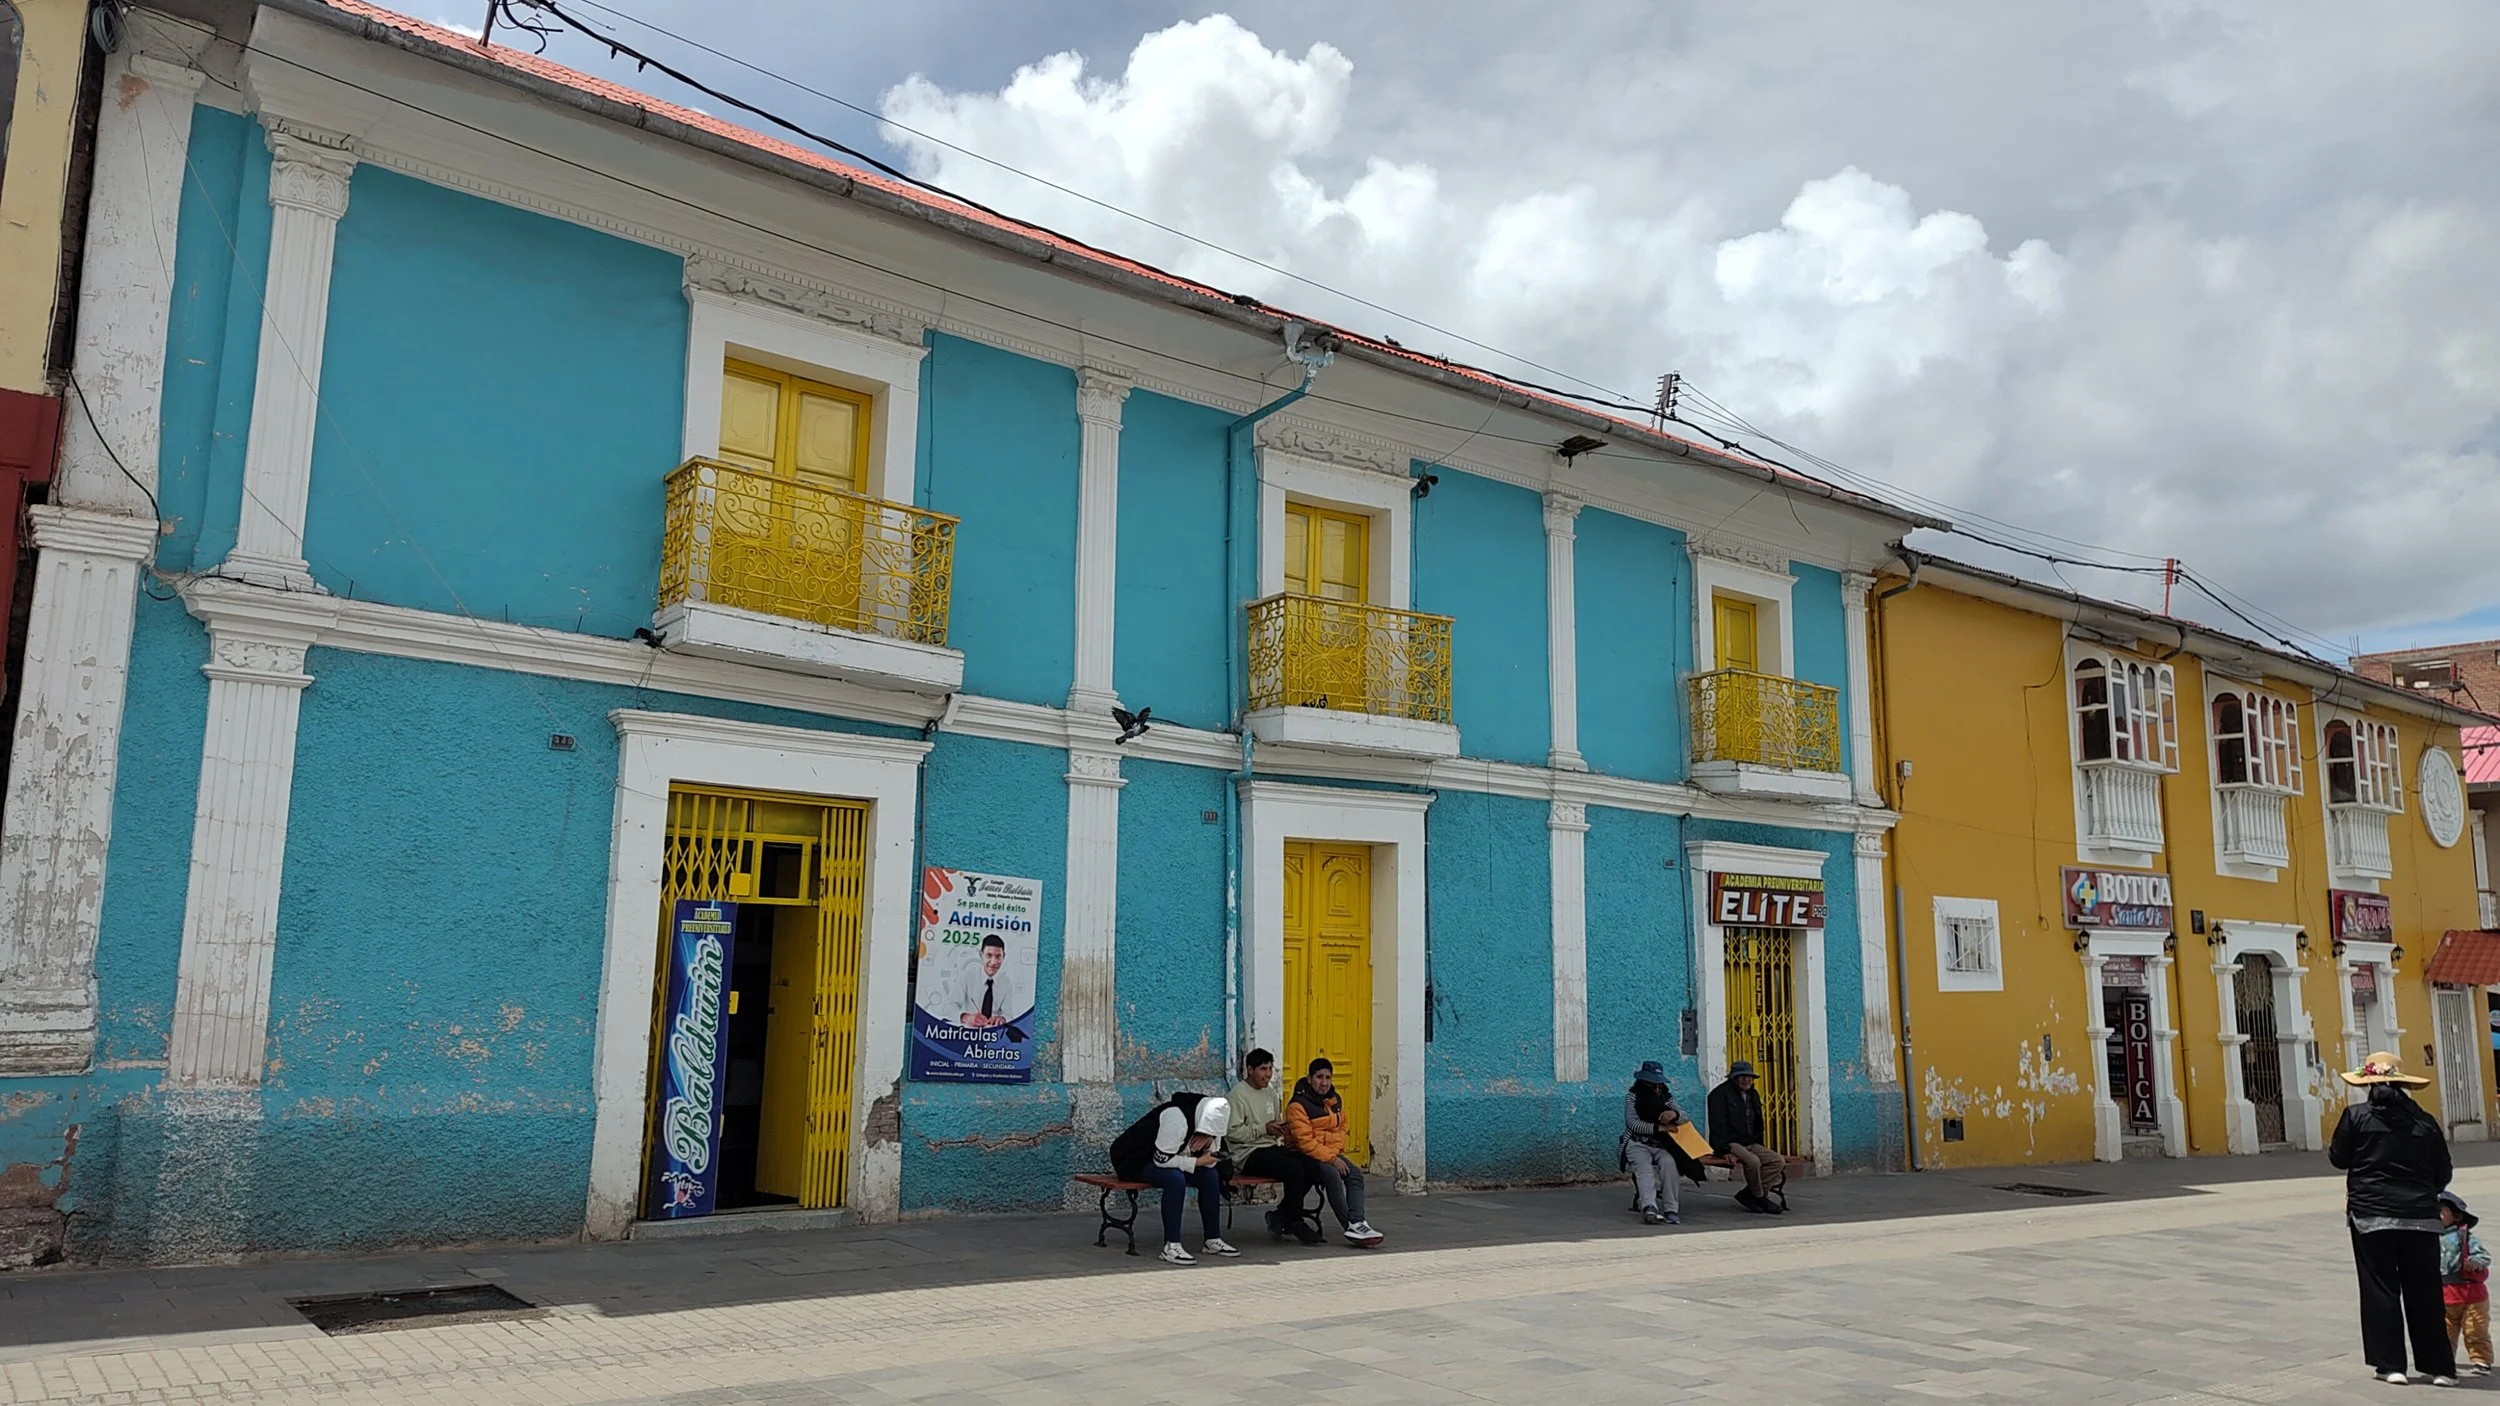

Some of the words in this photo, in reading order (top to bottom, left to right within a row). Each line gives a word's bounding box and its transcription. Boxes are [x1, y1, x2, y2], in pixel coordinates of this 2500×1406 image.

[1725, 874, 1761, 889] ACADEMIA
[1762, 877, 1824, 893] PREUNIVERSITARIA
[2097, 873, 2173, 906] BOTICA
[957, 899, 967, 907] Se
[968, 901, 990, 909] parte
[992, 902, 1005, 910] del
[1006, 903, 1026, 913] éxito
[1721, 891, 1810, 925] ELITE
[1812, 905, 1828, 917] PRO
[2109, 905, 2147, 926] Santa
[948, 911, 1031, 932] Admisión
[942, 929, 981, 946] 2025
[925, 1024, 998, 1042] Matrículas
[664, 934, 724, 1174] Baldwin
[963, 1043, 1020, 1060] Abiertas
[2130, 1003, 2152, 1118] BOTICA
[929, 1060, 950, 1068] INICIAL
[954, 1061, 979, 1069] PRIMARIA
[982, 1062, 1015, 1070] SECUNDARIA
